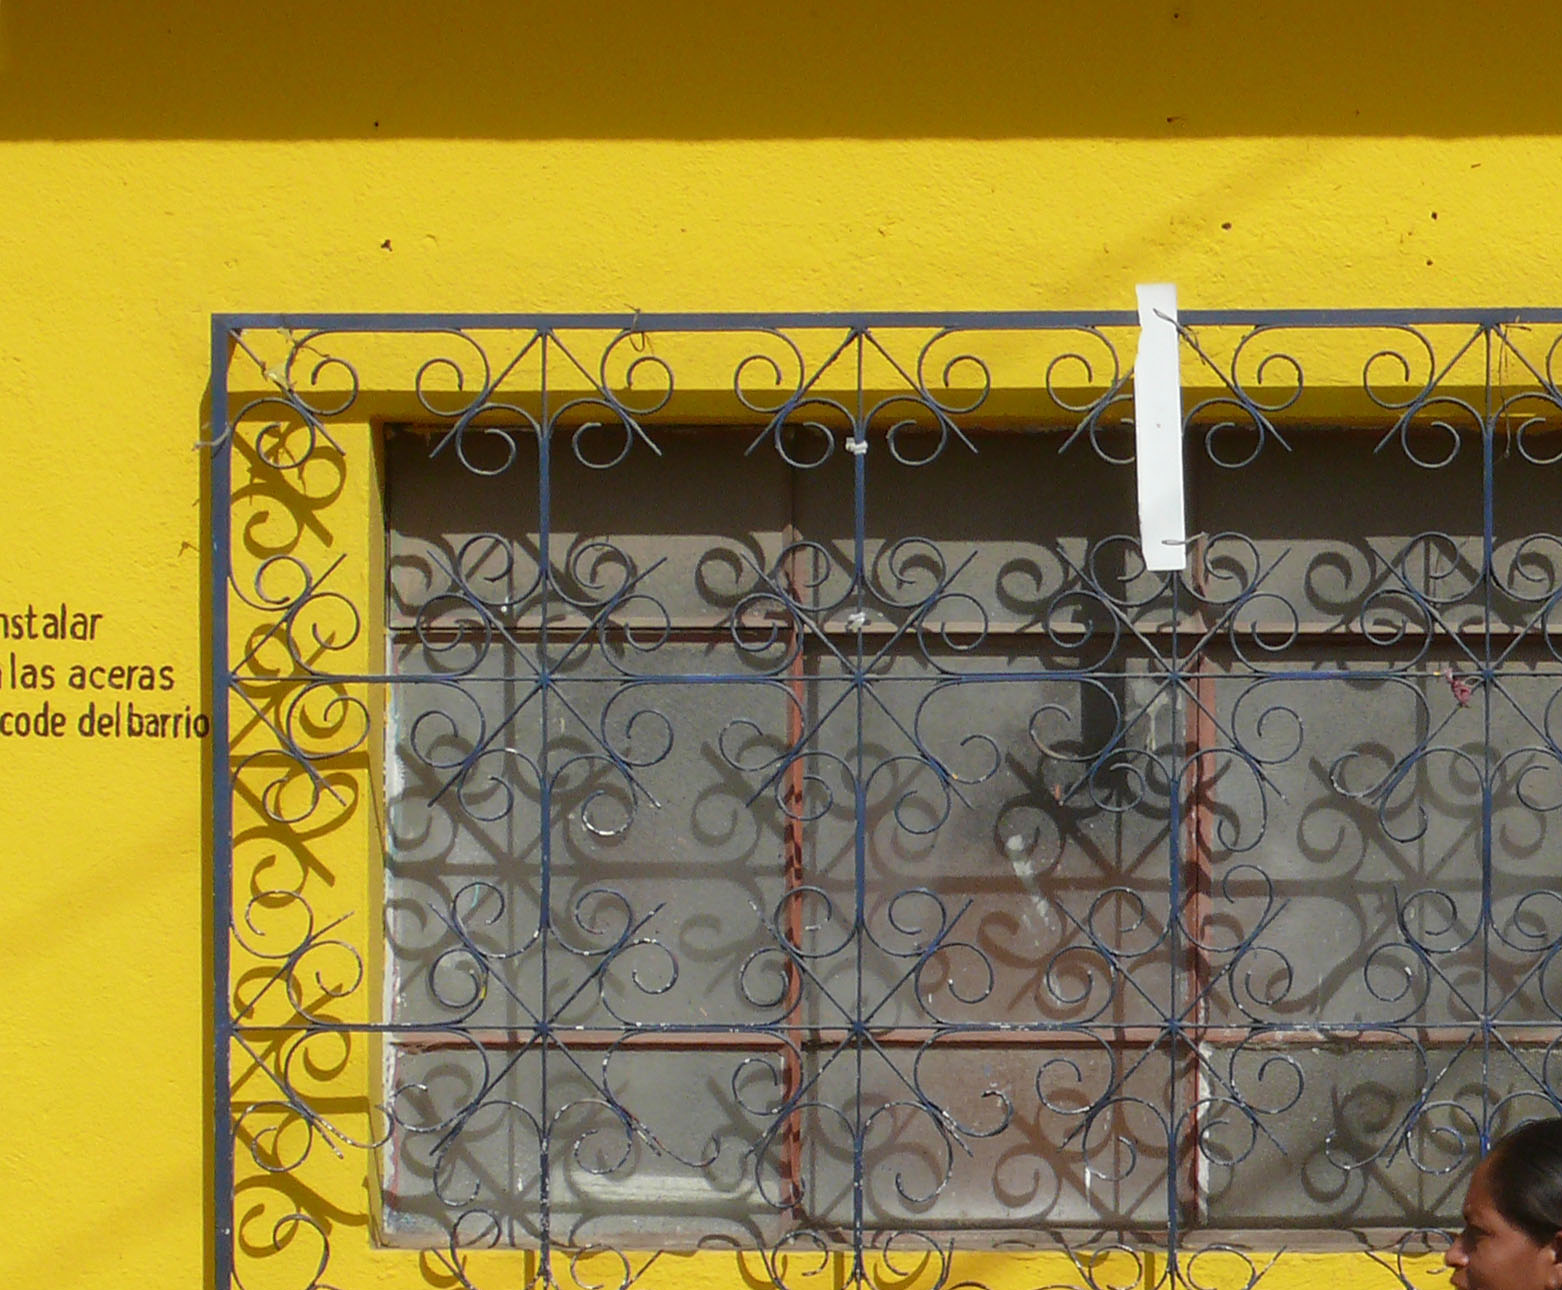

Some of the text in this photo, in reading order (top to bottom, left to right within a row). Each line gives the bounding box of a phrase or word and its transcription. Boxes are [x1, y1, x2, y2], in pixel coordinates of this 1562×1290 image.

[10, 651, 56, 690] las
[67, 664, 175, 691] aceras
[0, 700, 67, 738] code
